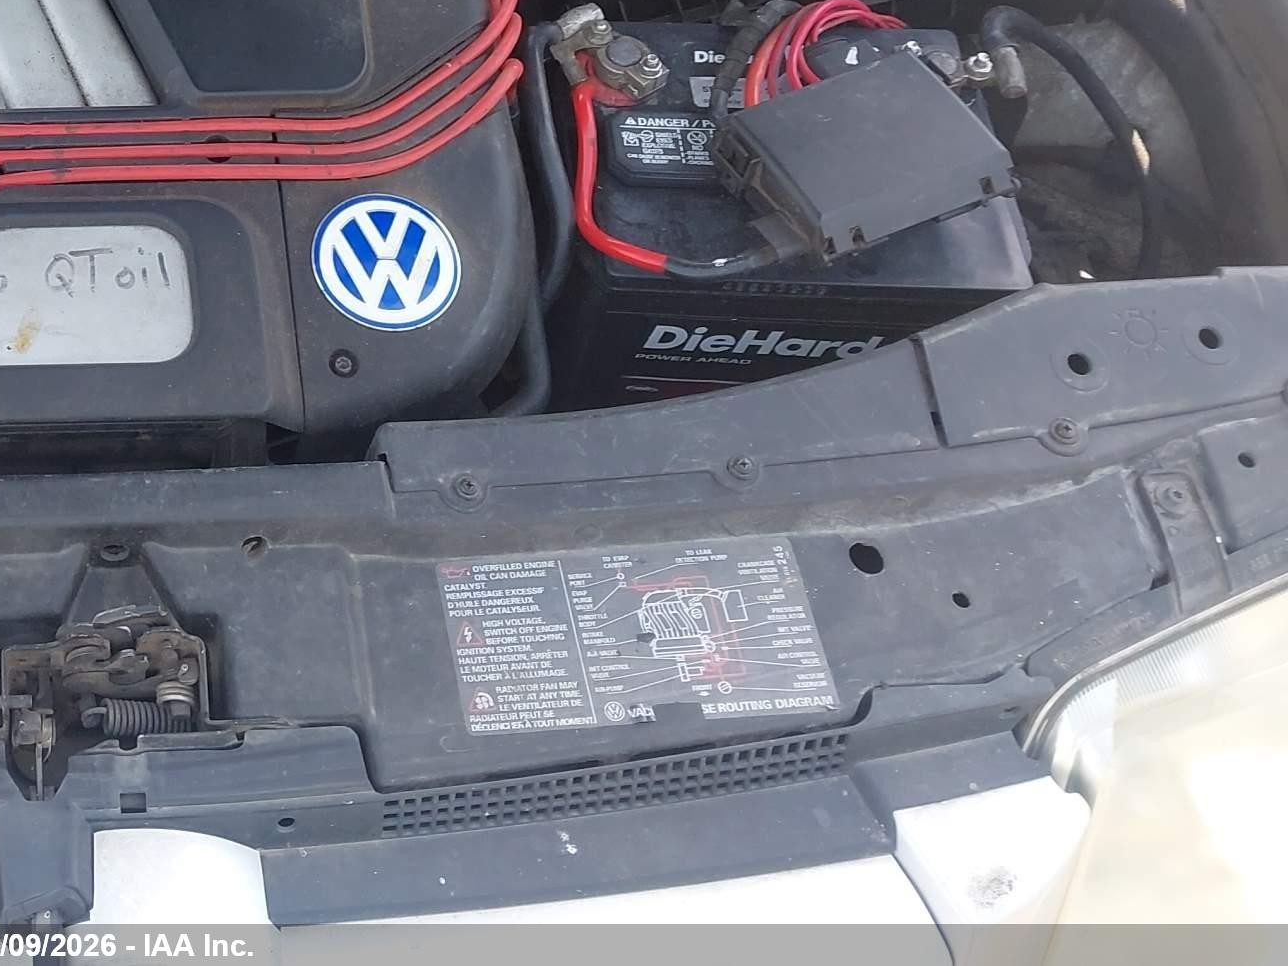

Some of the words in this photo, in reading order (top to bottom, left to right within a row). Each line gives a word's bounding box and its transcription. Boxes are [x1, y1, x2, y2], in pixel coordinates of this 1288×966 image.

[638, 118, 689, 127] DANGER
[643, 325, 884, 359] DieHard
[634, 353, 692, 362] POWER
[696, 356, 752, 365] AHEAD
[472, 563, 522, 572] OVERFILLED
[524, 560, 556, 568] ENGINE
[490, 572, 508, 580] CAN
[510, 570, 547, 578] DAMAGE
[446, 589, 504, 600] REMPLISSAGE
[505, 587, 544, 596] EXCESSIF
[449, 609, 473, 617] POUR
[519, 626, 534, 634] OFF
[536, 624, 568, 632] ENGINE
[486, 636, 519, 645] BEFORE
[521, 634, 565, 642] TOUCHING
[456, 647, 494, 656] IGNITION
[458, 656, 488, 664] HAUTE
[531, 649, 568, 659] ARRÊTER
[460, 666, 470, 674] LE
[472, 663, 508, 672] MOTEUR
[510, 662, 538, 670] AVANT
[462, 673, 502, 682] TOUCHER
[540, 682, 557, 690] FAN
[559, 681, 578, 689] MAY
[539, 692, 558, 700] ANY
[511, 700, 569, 710] VENTILATEUR
[718, 700, 772, 713] ROUTING
[775, 696, 834, 710] DIAGRAM
[470, 713, 519, 722] RADIATEUR
[520, 711, 541, 720] PEUT
[543, 710, 555, 718] SE
[524, 719, 532, 728] À
[533, 719, 555, 727] TOUT
